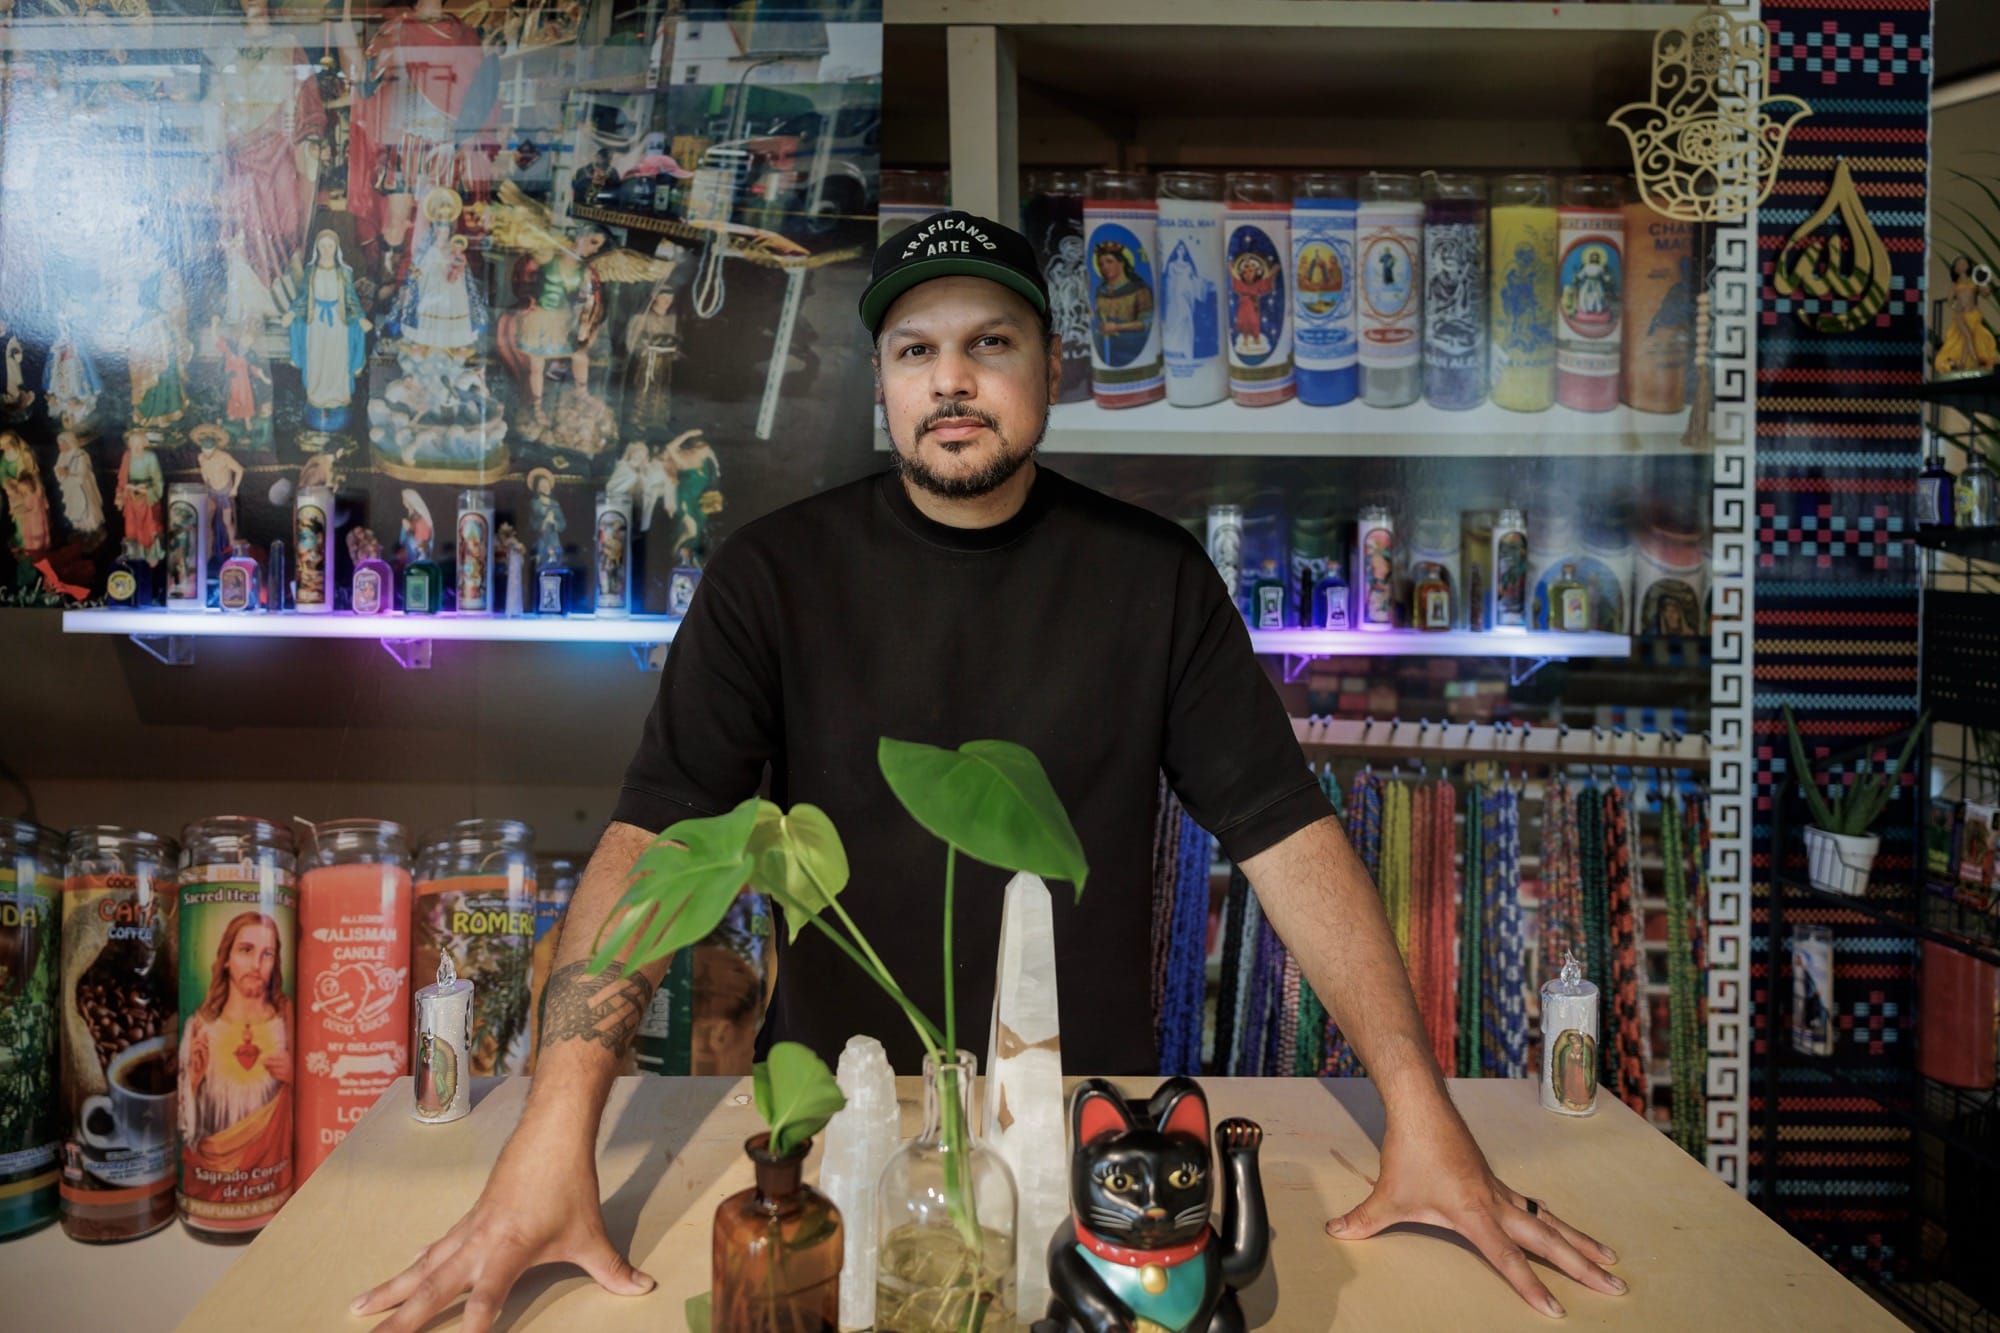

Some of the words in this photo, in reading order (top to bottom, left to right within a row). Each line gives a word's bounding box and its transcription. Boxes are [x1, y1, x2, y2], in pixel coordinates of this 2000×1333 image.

[901, 218, 997, 260] TRAFICANDO
[927, 240, 970, 257] ARTE
[183, 888, 224, 905] Sacred
[227, 888, 267, 903] Hear
[0, 905, 37, 929] DA
[108, 926, 153, 940] COFFEE
[333, 945, 386, 960] CANDLE
[195, 1167, 249, 1185] Sagrado
[223, 1183, 240, 1198] de
